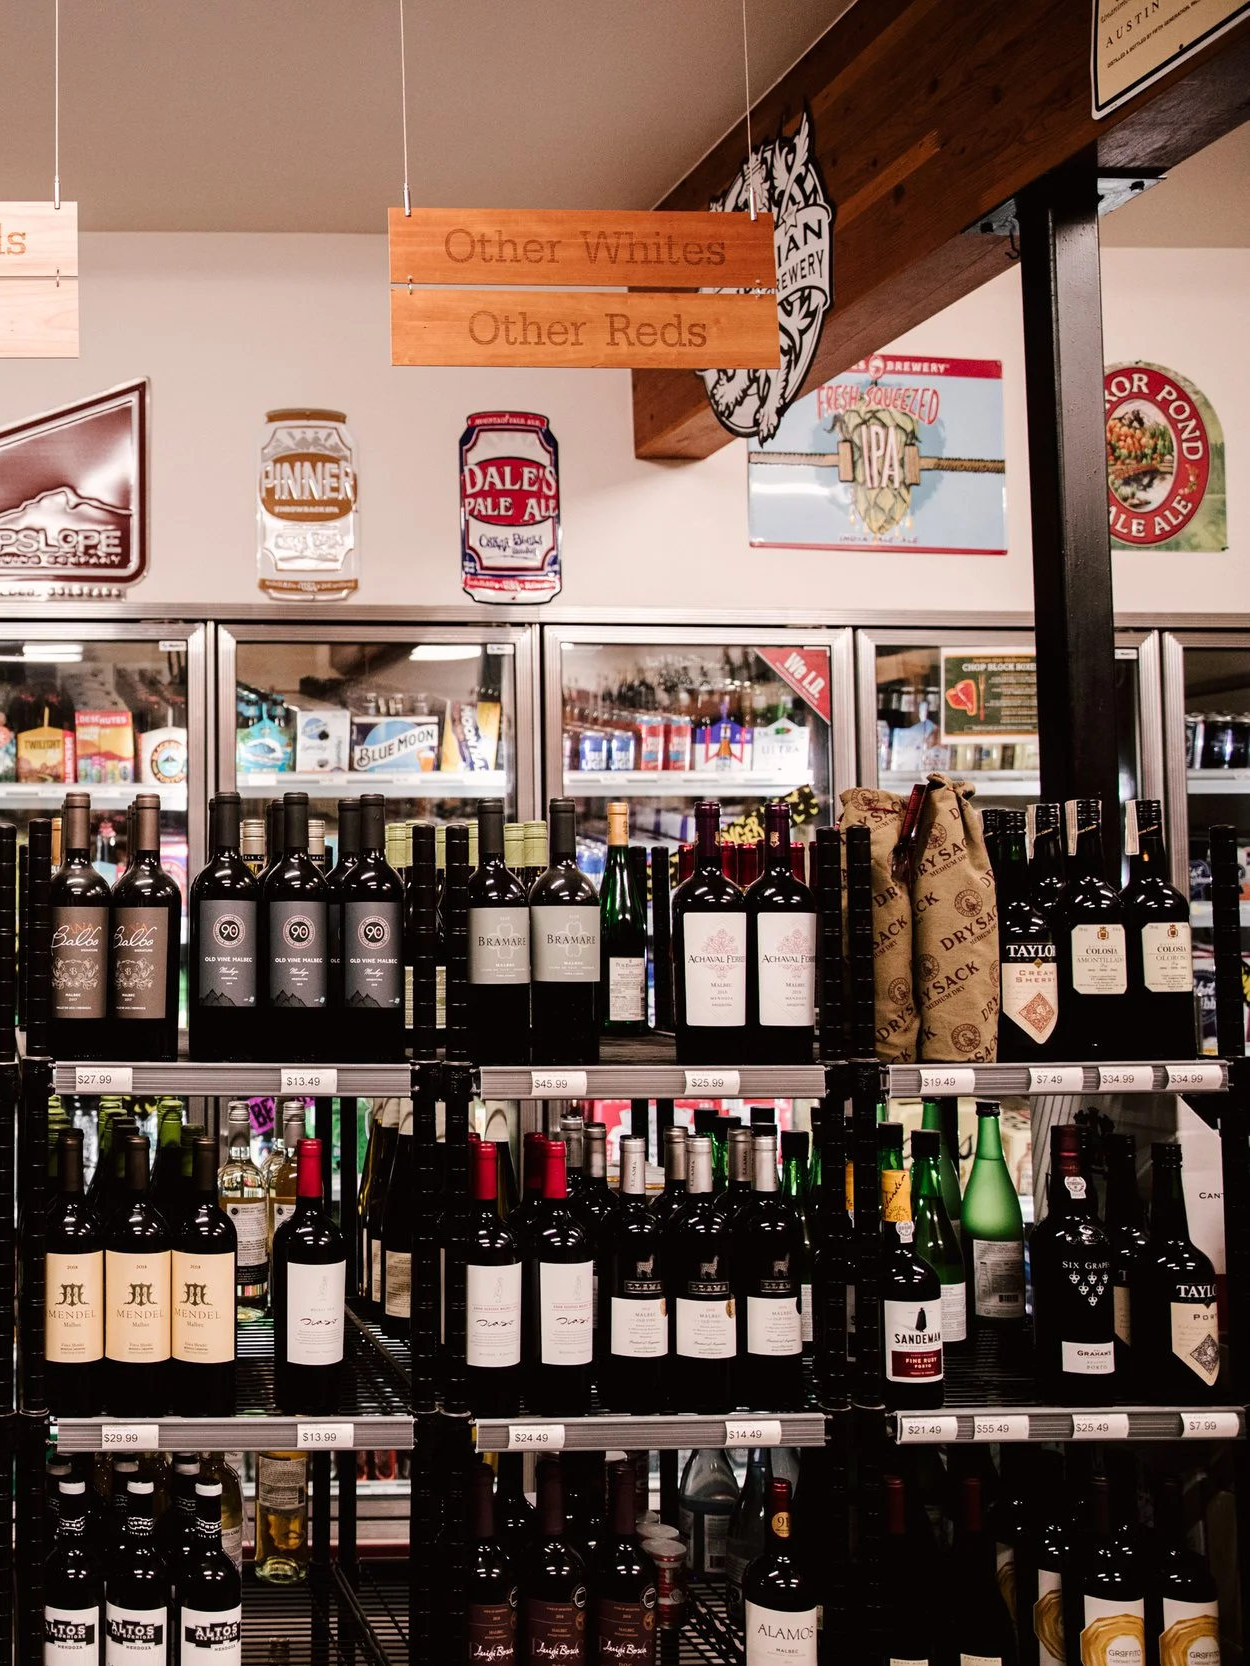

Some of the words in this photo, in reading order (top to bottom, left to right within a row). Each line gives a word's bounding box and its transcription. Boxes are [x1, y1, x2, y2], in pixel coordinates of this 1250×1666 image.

[1105, 0, 1160, 48] AUSTIN
[443, 228, 562, 265] Other
[579, 230, 726, 267] Whites
[468, 310, 587, 347] Other
[605, 313, 708, 349] Reds
[885, 361, 945, 374] BREWERY
[816, 383, 860, 420] FRESH
[865, 385, 940, 426] SQUEEZED
[1154, 384, 1205, 461] POND
[860, 424, 901, 490] IPA
[261, 459, 356, 501] PINNER
[462, 462, 558, 497] DALE'S
[464, 497, 514, 521] PALE
[523, 498, 559, 522] ALE
[1153, 494, 1192, 535] ALE
[356, 740, 396, 767] BLUE
[397, 729, 435, 751] MOON
[478, 935, 527, 948] BRAMARE
[546, 933, 596, 946] BRAMARE
[940, 922, 977, 951] DRY
[687, 954, 724, 964] ACHAVAL
[761, 954, 800, 964] ACHAVAL
[932, 960, 980, 995] SACK
[925, 992, 953, 1011] MEDIUM
[77, 1074, 112, 1085] $27.99
[286, 1076, 321, 1087] $13.49
[534, 1079, 568, 1090] $45.99
[691, 1078, 724, 1088] $25.99
[923, 1076, 956, 1087] $19.49
[1036, 1075, 1063, 1085] $7.49
[1101, 1074, 1135, 1085] $34.99
[1170, 1074, 1204, 1085] $34.99
[1062, 1260, 1080, 1270] SIX
[691, 1284, 727, 1292] LLAMA
[48, 1309, 97, 1319] MENDEL
[116, 1309, 165, 1319] MENDEL
[174, 1308, 221, 1320] MENDEL
[894, 1331, 941, 1345] SANDEMAN
[923, 1356, 938, 1364] RUBY
[907, 1424, 942, 1436] $21.49
[975, 1423, 1010, 1434] $55.49
[1075, 1422, 1110, 1434] $25.49
[1189, 1421, 1218, 1432] $7.99
[103, 1433, 138, 1443] $29.99
[302, 1431, 338, 1443] $13.99
[514, 1433, 549, 1444] $24.49
[728, 1429, 763, 1440] $14.49
[111, 1620, 156, 1636] ALTOS
[195, 1622, 238, 1637] ALTOS
[757, 1623, 815, 1640] ALAMOS
[775, 1647, 800, 1655] MALBEC
